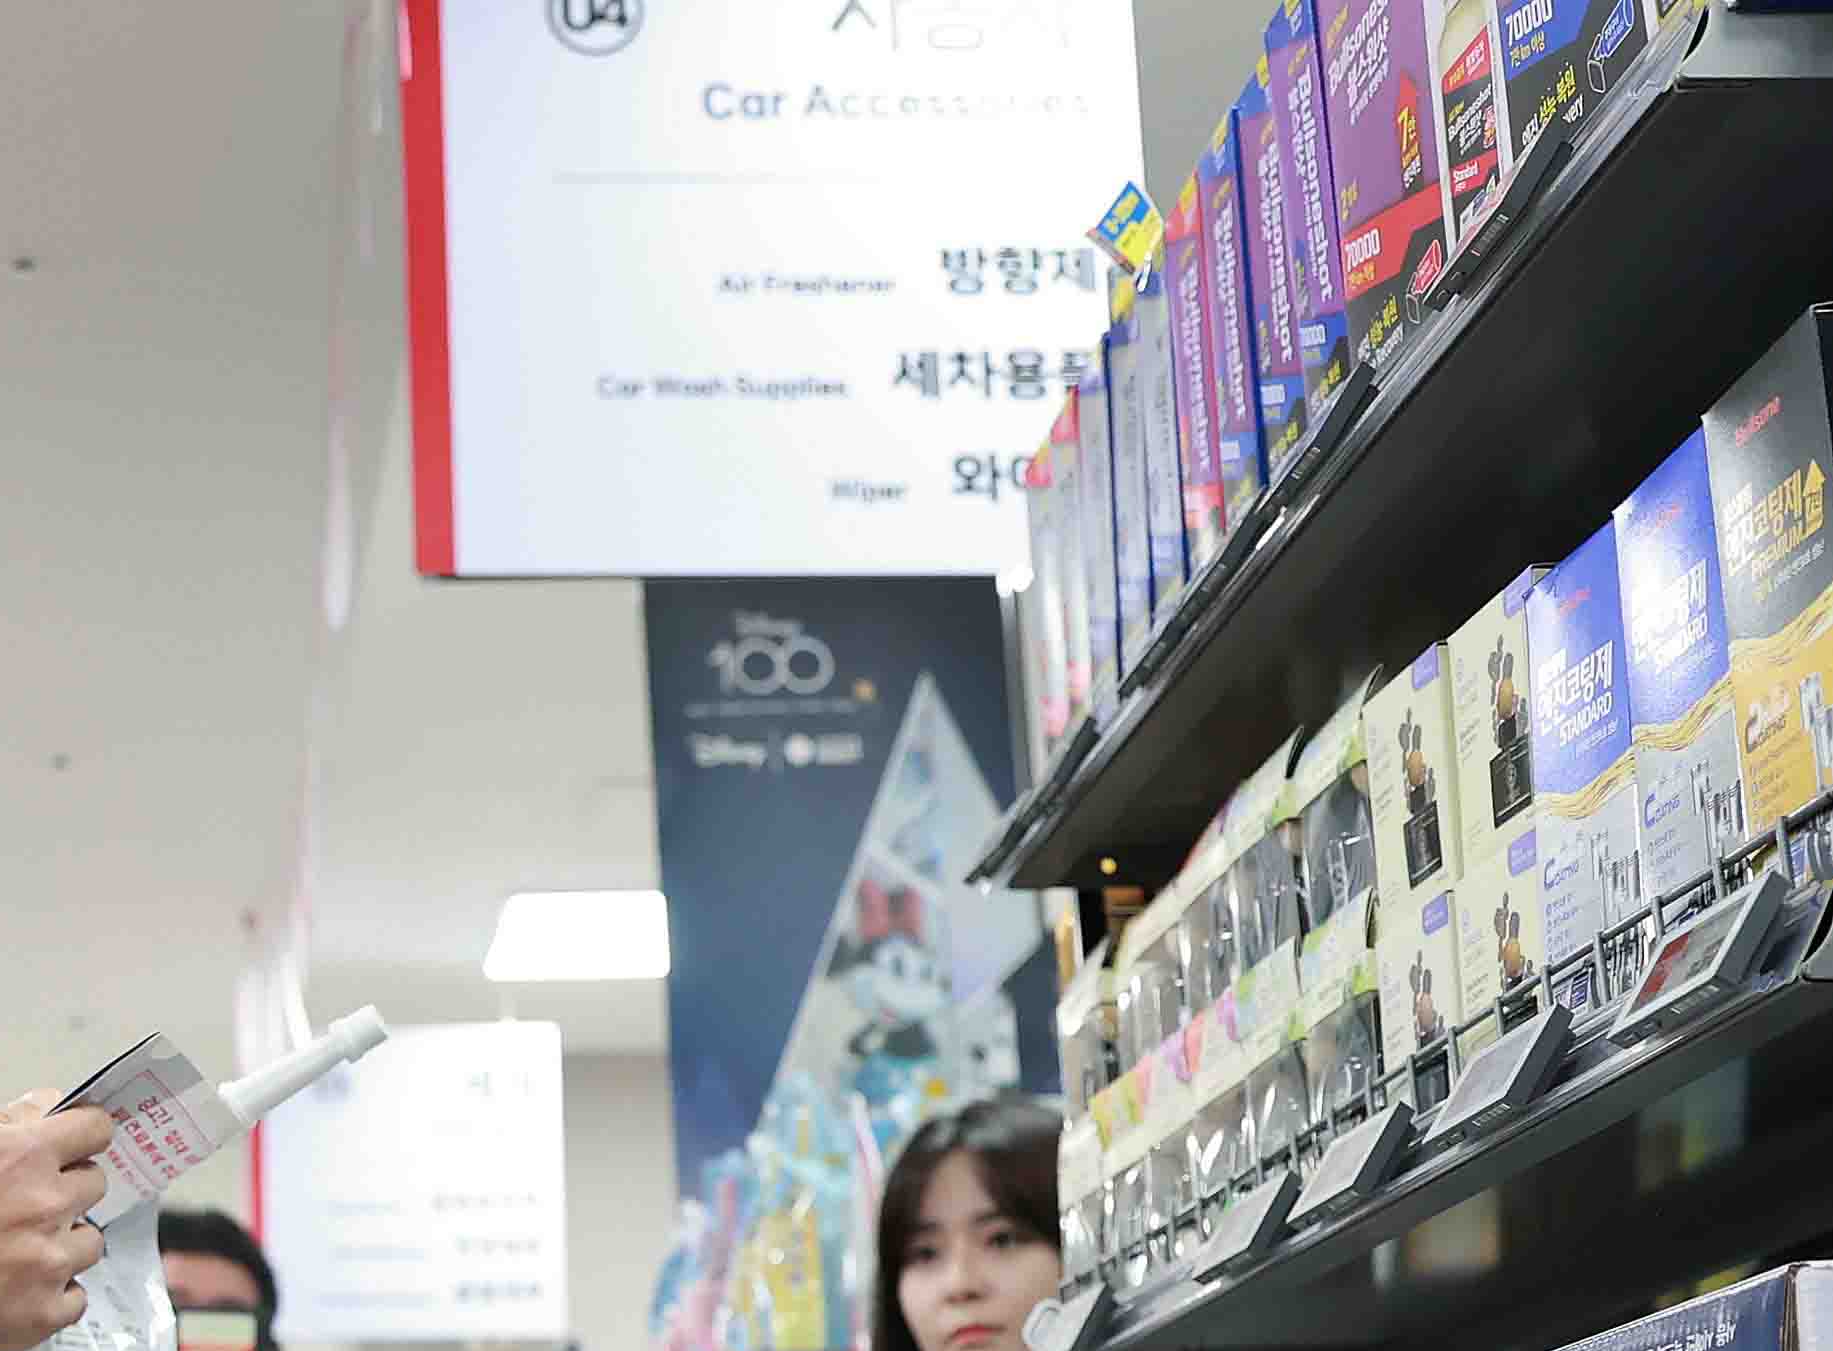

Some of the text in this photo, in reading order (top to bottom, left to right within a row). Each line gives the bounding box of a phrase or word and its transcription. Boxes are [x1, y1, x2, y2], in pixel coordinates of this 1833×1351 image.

[1505, 0, 1554, 47] 70000
[702, 82, 785, 120] Car
[1296, 64, 1334, 302] Bullsoneshot
[940, 247, 1097, 295] 방향제
[597, 376, 644, 398] Car
[1559, 691, 1614, 747] STANDARD
[1714, 1320, 1736, 1348] 사용
